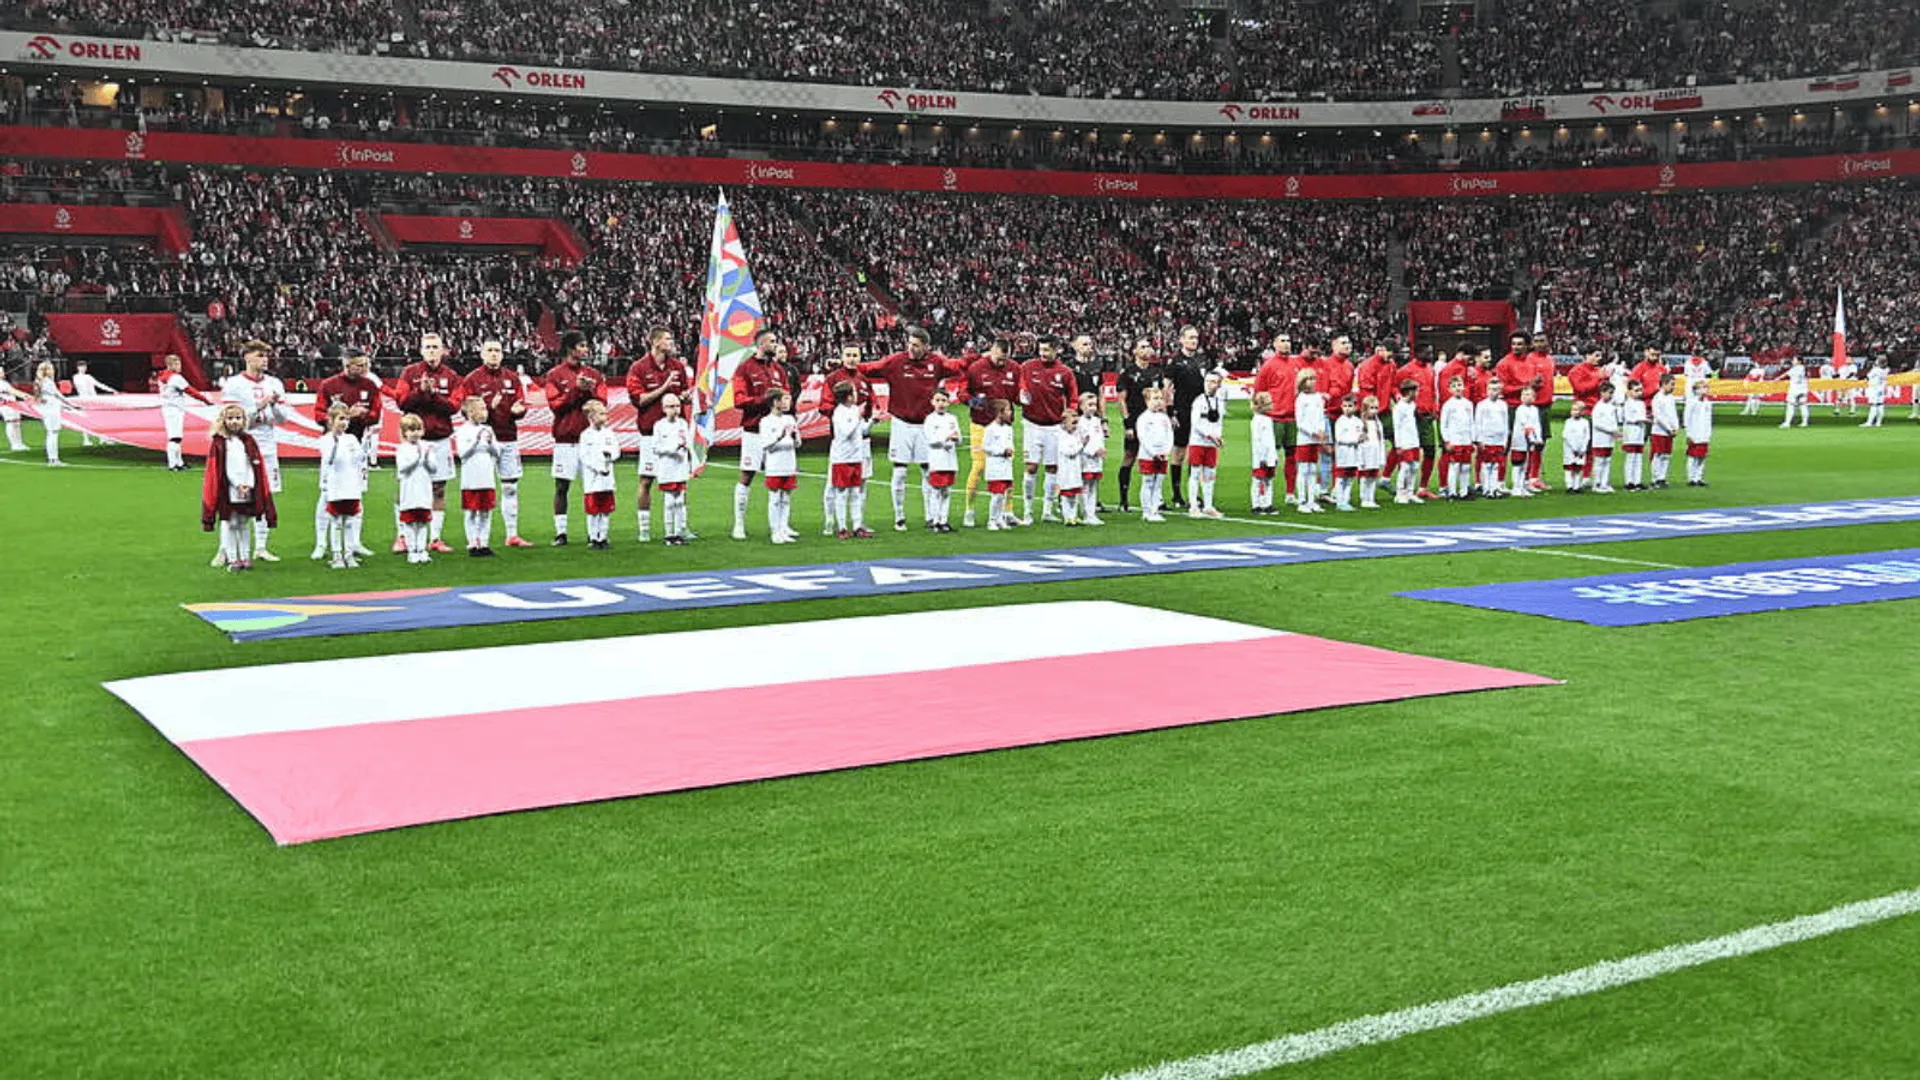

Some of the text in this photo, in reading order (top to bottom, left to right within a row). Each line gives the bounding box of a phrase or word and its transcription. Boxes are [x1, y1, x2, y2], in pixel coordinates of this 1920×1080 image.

[69, 41, 141, 61] ORLEN
[526, 72, 585, 89] ORLEN
[906, 94, 956, 110] ORLEN
[1620, 95, 1654, 109] ORL
[1249, 106, 1299, 119] ORLEN
[351, 147, 394, 162] InPost
[758, 166, 795, 179] InPost
[1852, 158, 1891, 173] InPost
[1105, 179, 1138, 191] InPost
[1461, 178, 1497, 189] InPost
[458, 564, 1000, 609] UEFA
[967, 521, 1640, 574] NATIONS
